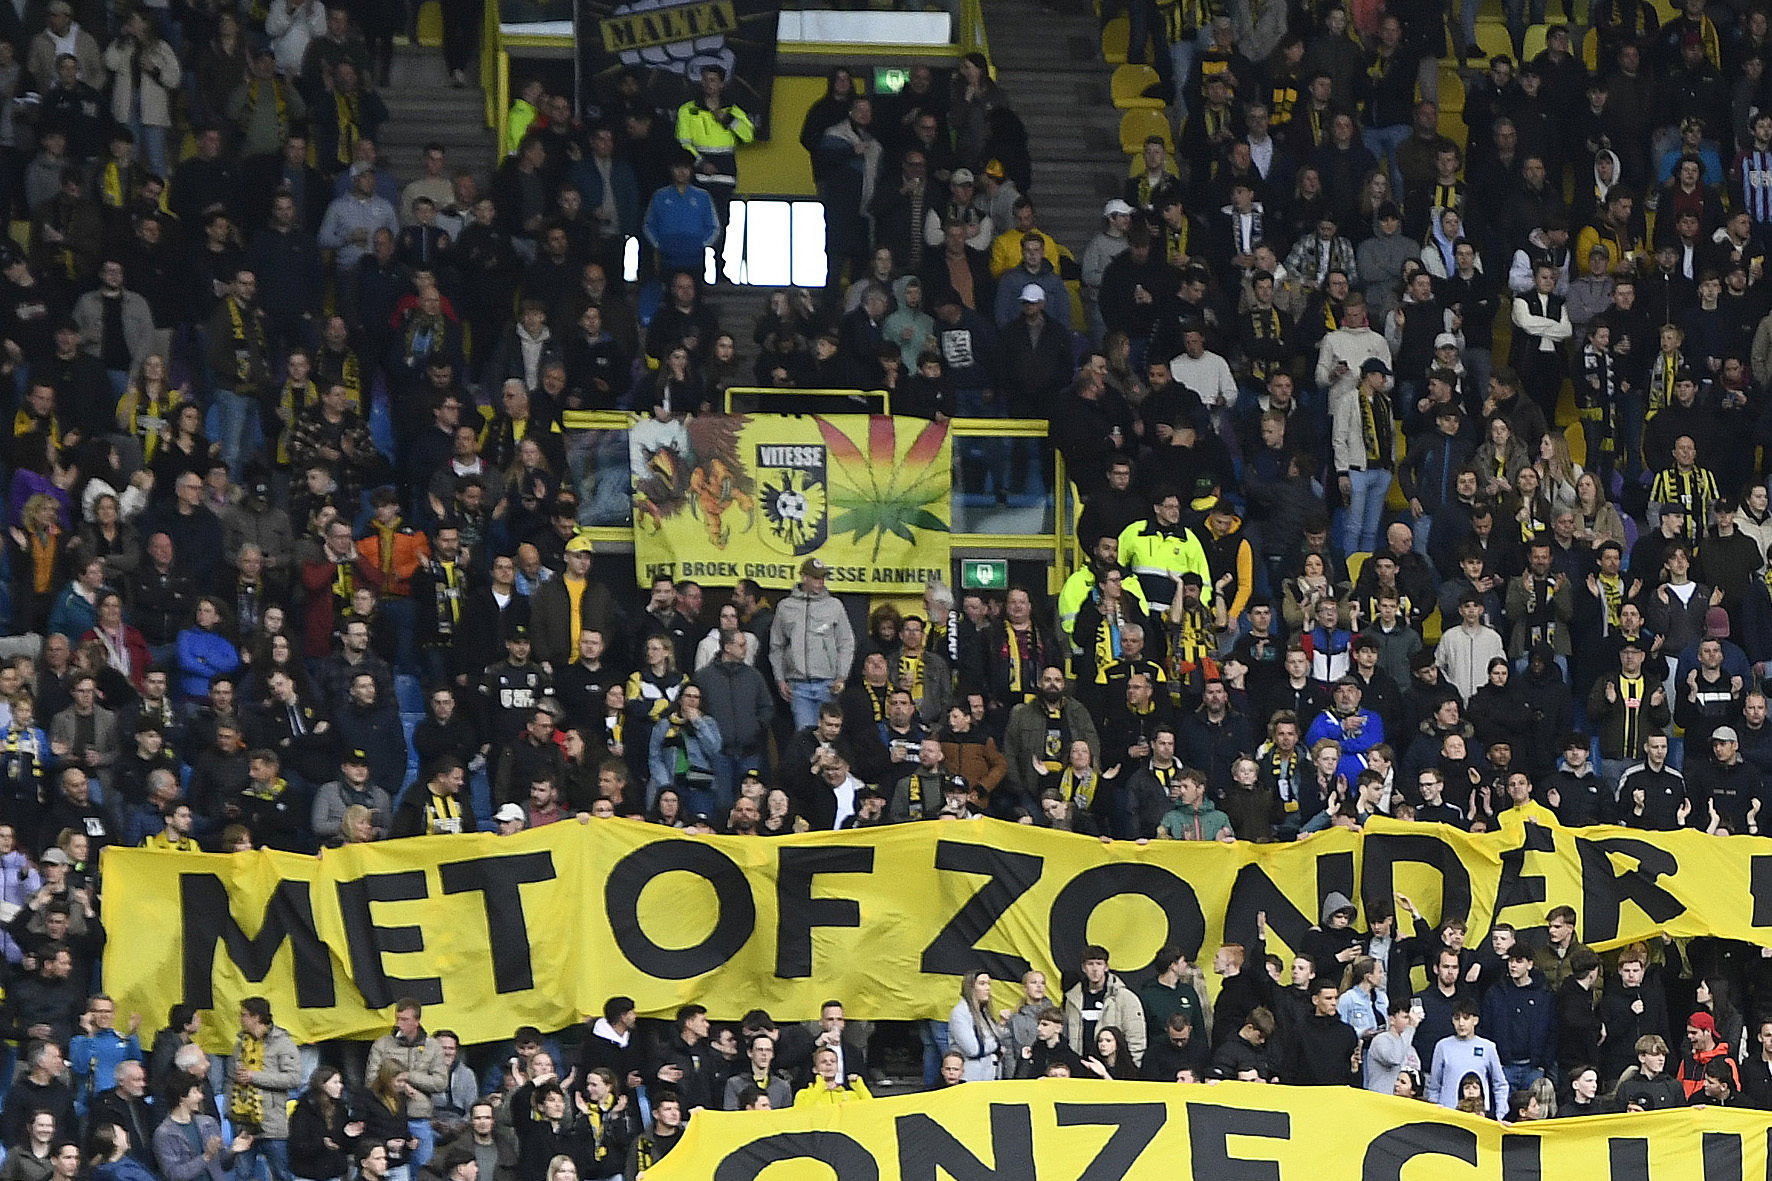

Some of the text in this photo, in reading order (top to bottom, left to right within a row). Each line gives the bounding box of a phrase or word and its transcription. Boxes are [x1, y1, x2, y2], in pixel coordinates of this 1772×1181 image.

[607, 4, 729, 46] MALTA
[760, 446, 824, 468] VITESSE
[645, 562, 941, 583] HET BROEK GROET ESSE ARNHEM
[179, 850, 556, 1010] MET
[604, 838, 874, 980] OF
[921, 822, 1687, 991] ZONDER
